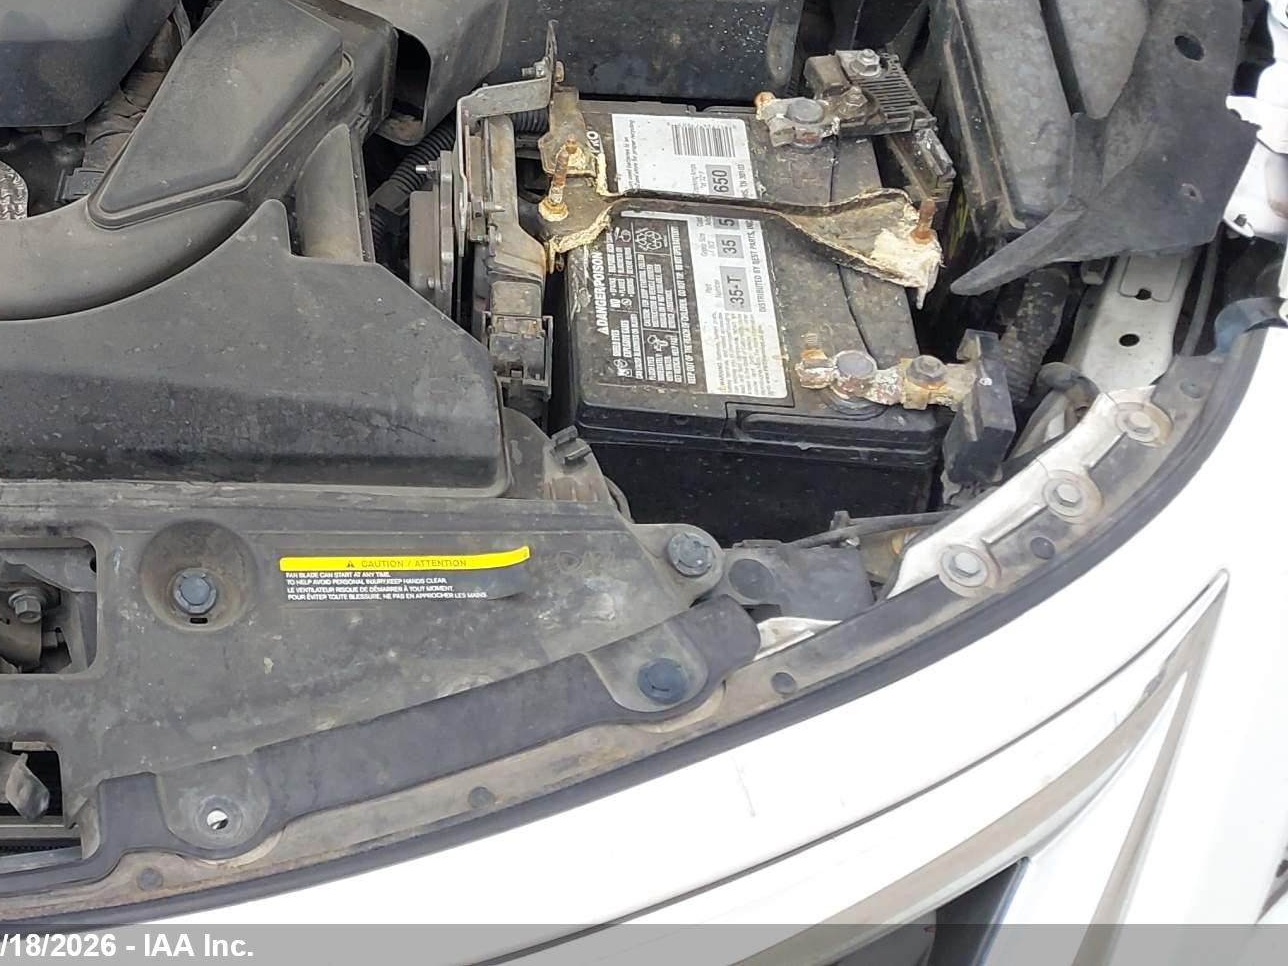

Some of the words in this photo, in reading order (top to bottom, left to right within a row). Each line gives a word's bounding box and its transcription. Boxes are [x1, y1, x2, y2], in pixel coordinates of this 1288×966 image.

[712, 170, 729, 192] 650
[722, 240, 737, 254] 35
[727, 275, 744, 304] 35-T
[754, 275, 766, 312] DISTRIBUTED
[361, 560, 404, 568] CAUTION
[414, 559, 467, 567] ATTENTION
